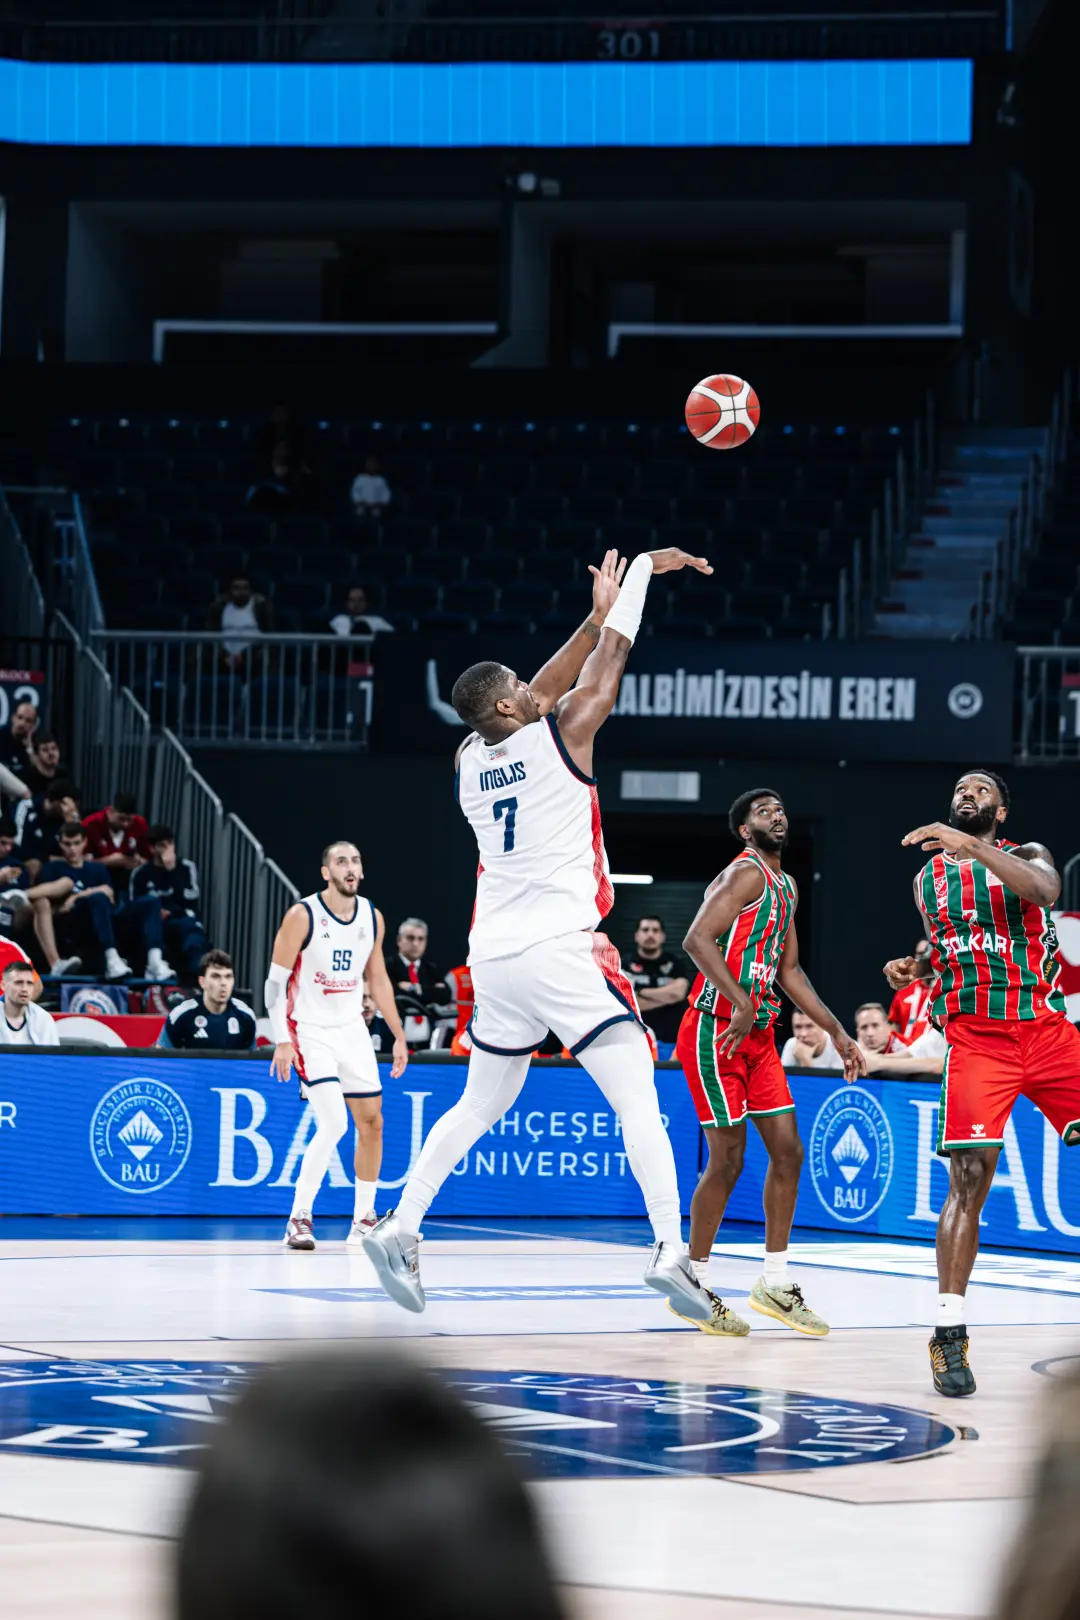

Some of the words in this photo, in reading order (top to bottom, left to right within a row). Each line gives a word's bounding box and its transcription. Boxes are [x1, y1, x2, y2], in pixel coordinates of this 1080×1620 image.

[597, 29, 660, 59] 301
[611, 668, 832, 718] ALBİMİZDESİN
[839, 677, 916, 720] EREN
[480, 761, 527, 792] INGLIS
[493, 797, 518, 853] 7
[332, 949, 352, 972] 55
[121, 1163, 160, 1182] BAU
[451, 1150, 628, 1176] UNIVERSIT
[833, 1186, 867, 1210] BAU
